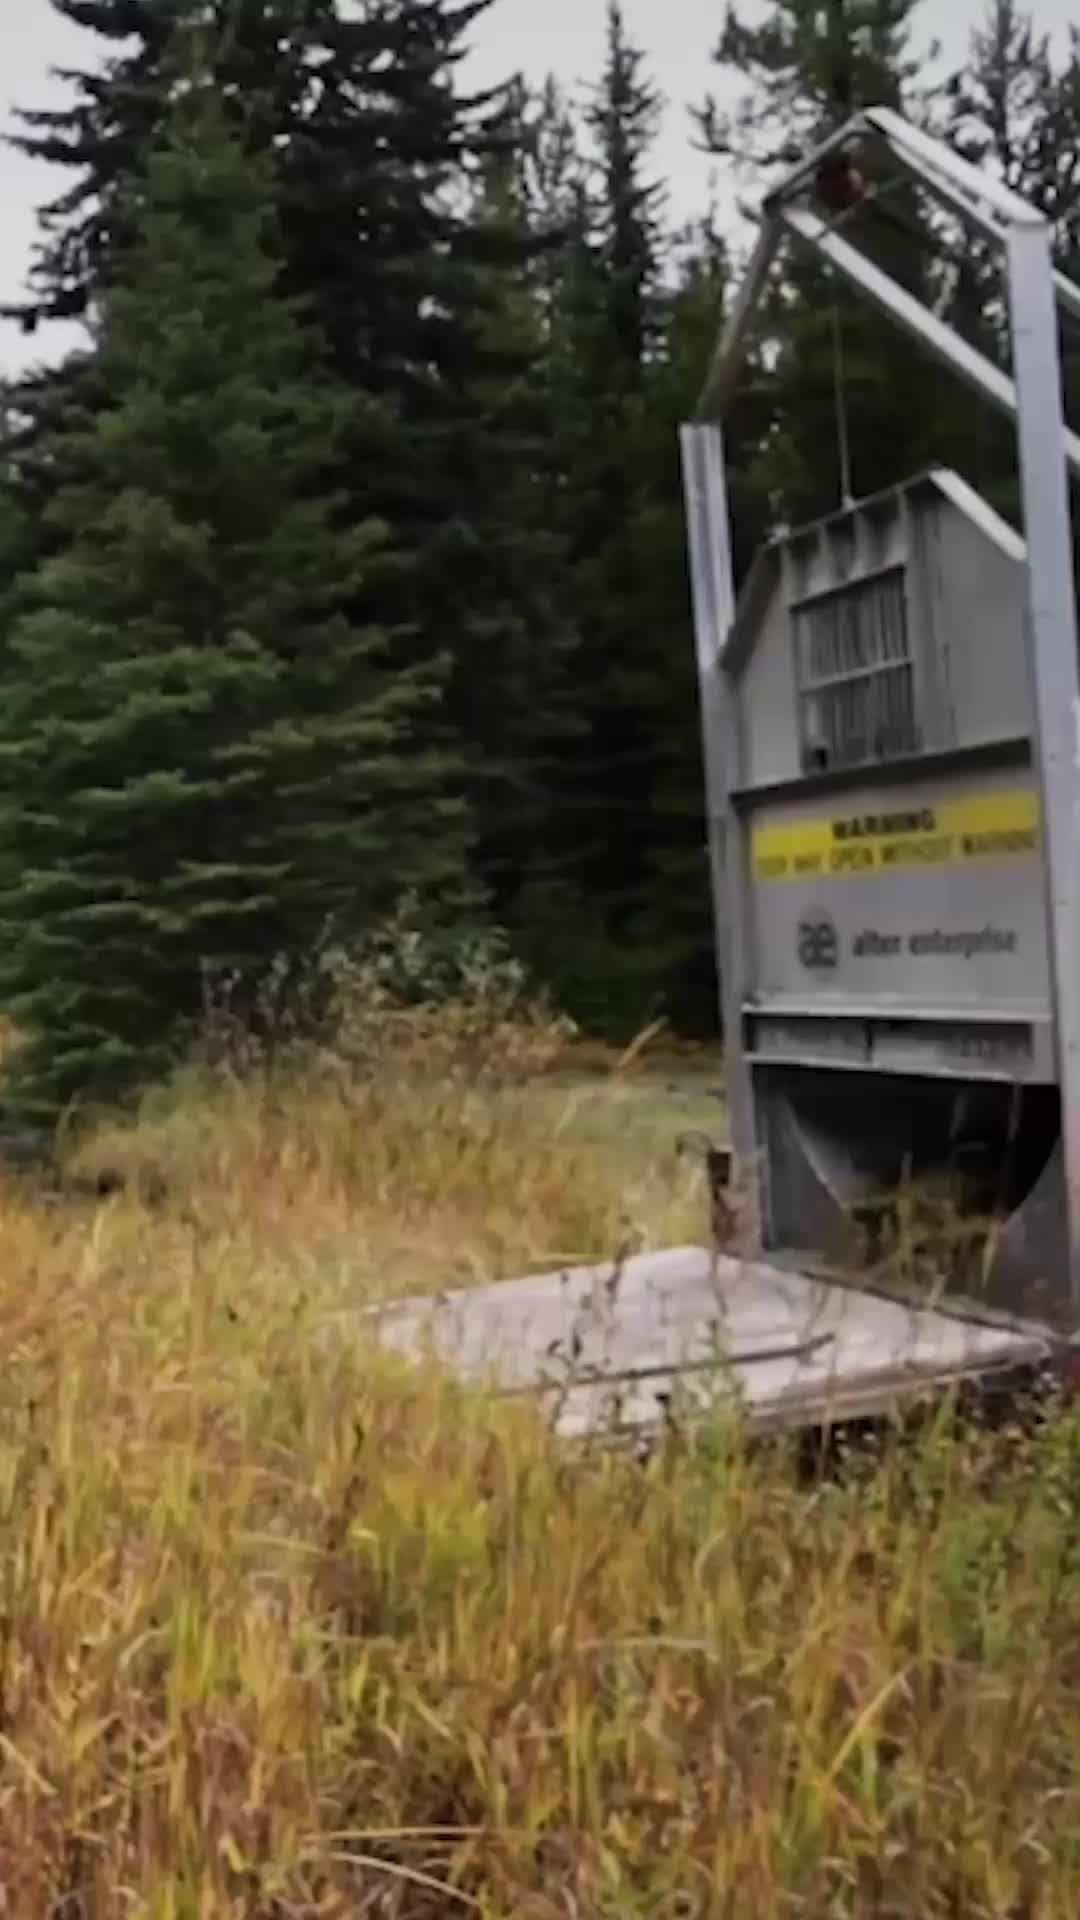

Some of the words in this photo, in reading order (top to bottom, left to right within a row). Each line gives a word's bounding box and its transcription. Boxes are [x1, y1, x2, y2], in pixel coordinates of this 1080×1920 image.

[832, 808, 937, 840] WARNING
[830, 846, 874, 871] OPEN
[908, 921, 1017, 959] enterprise
